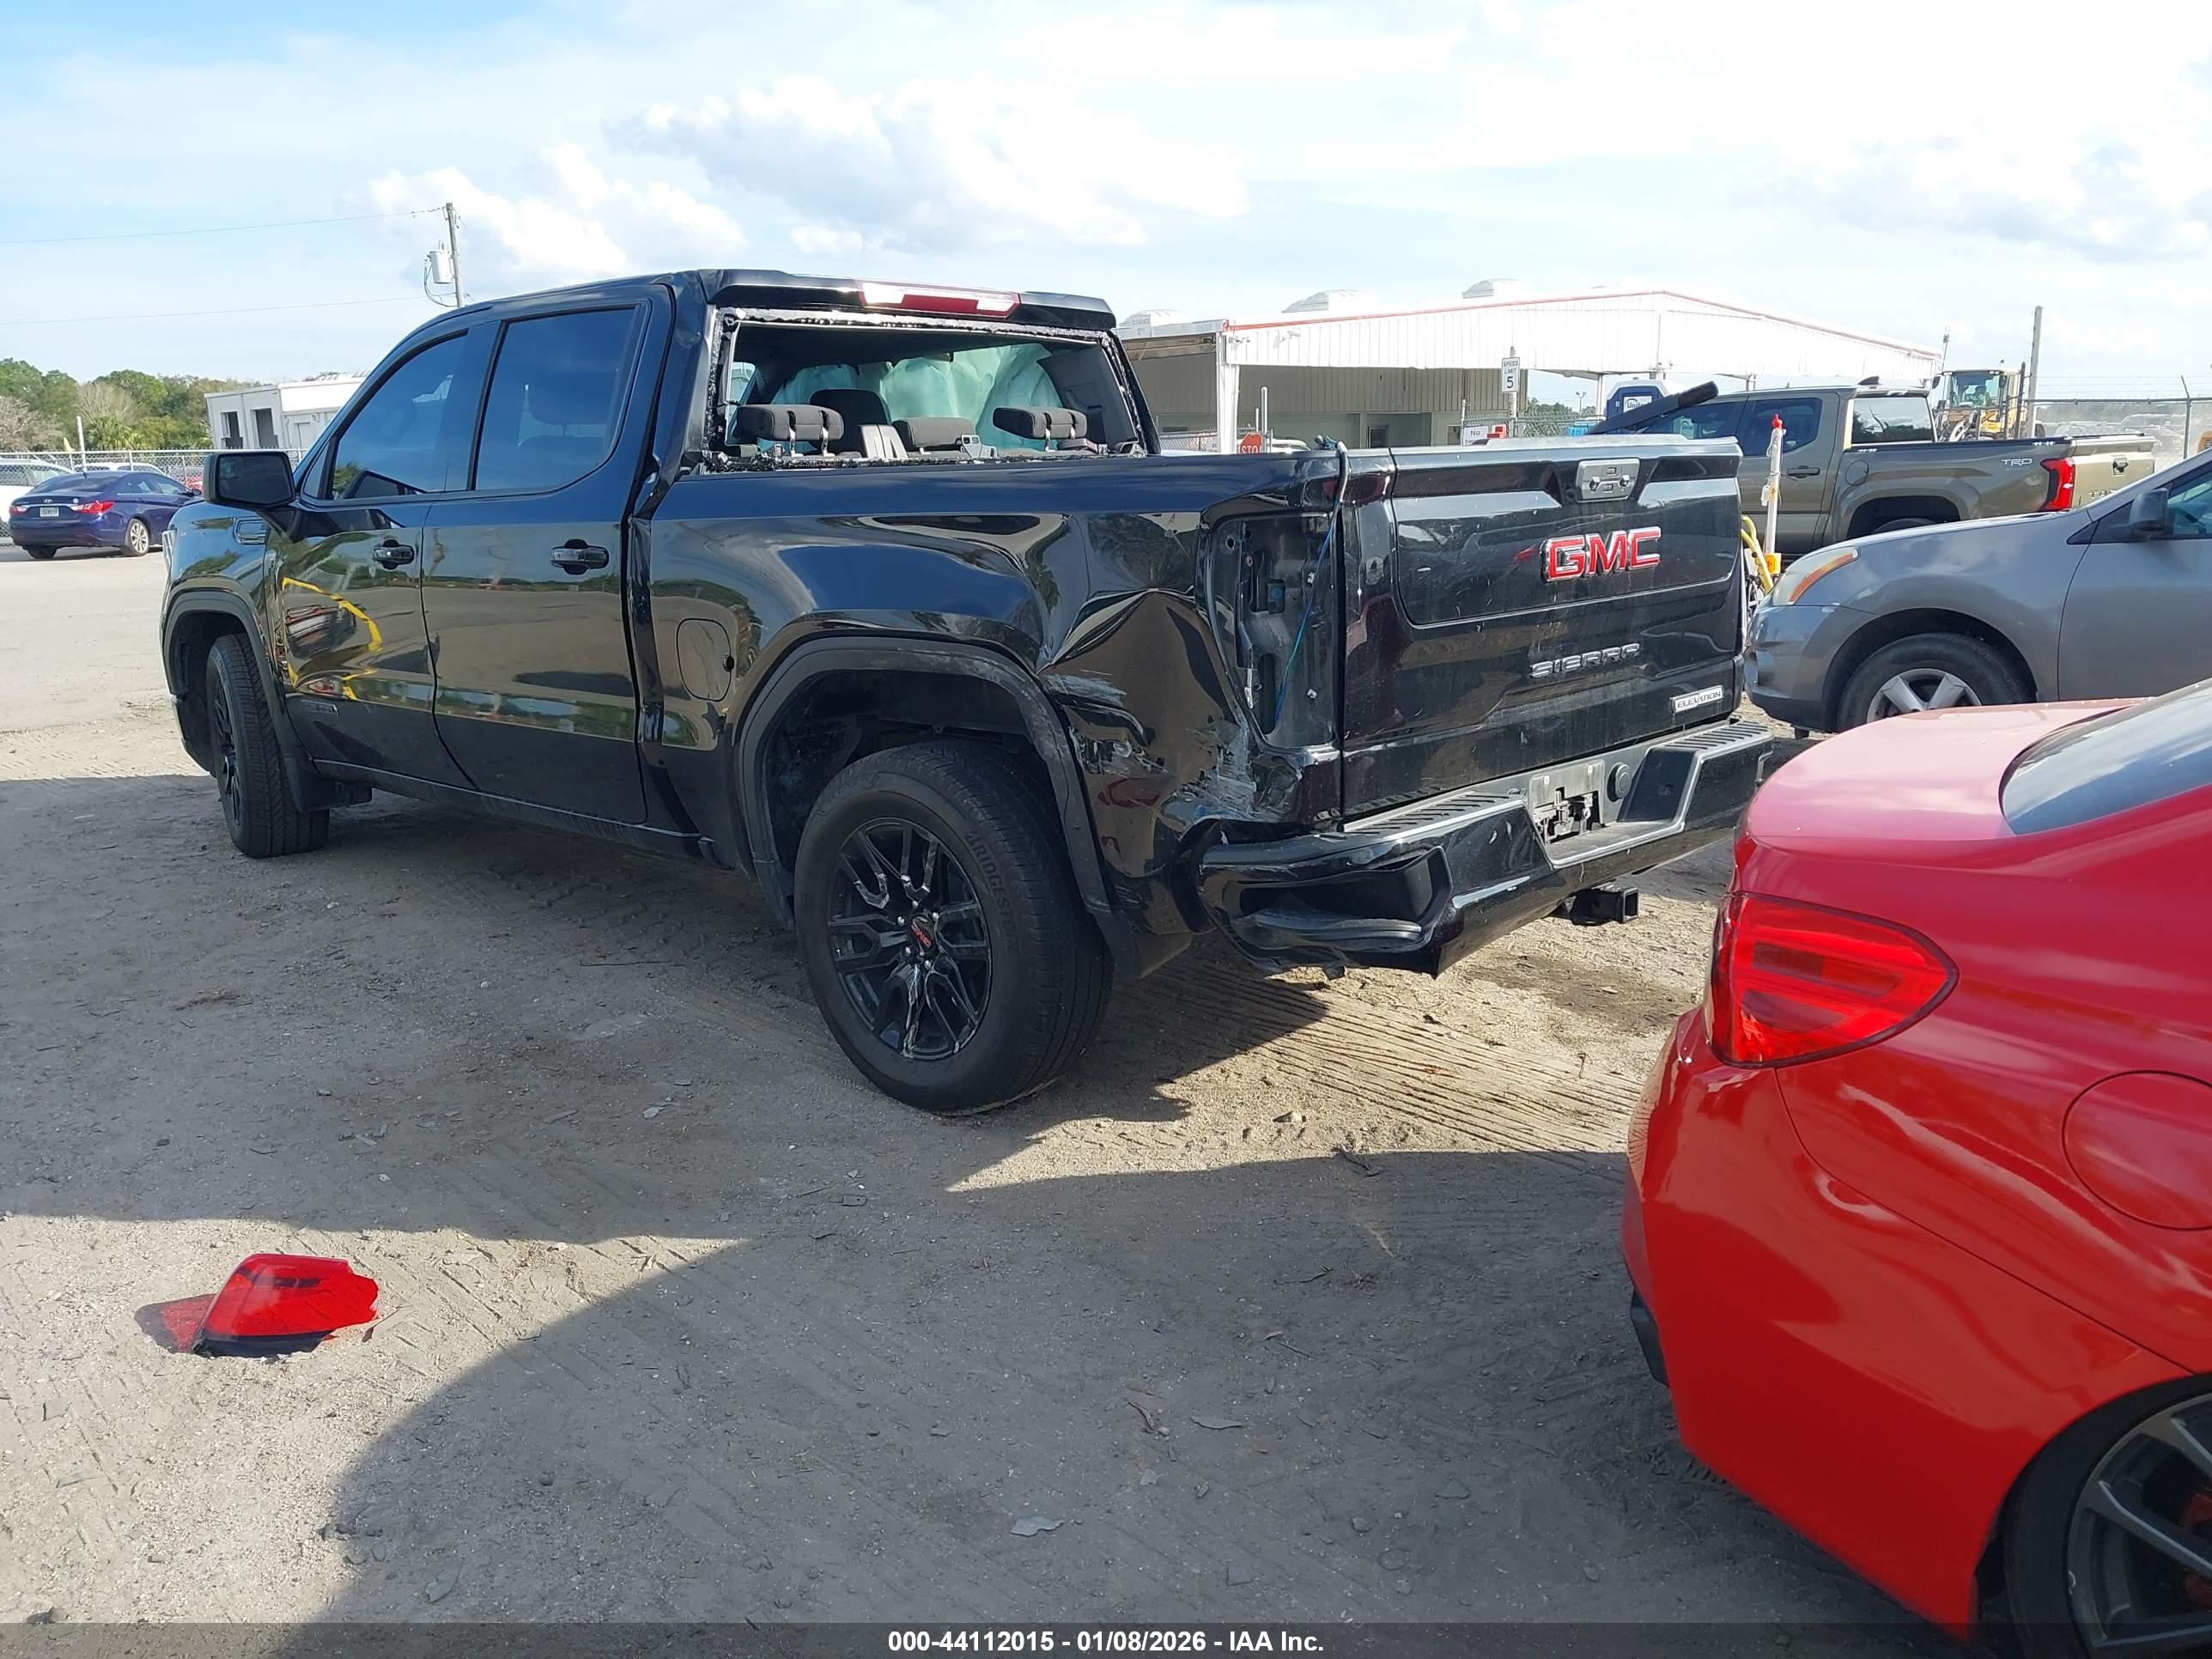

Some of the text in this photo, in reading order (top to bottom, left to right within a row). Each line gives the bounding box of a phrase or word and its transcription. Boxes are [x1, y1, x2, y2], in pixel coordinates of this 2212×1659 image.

[1507, 376, 1514, 389] 5
[2001, 458, 2033, 467] TRD
[1543, 526, 1662, 582] GMC
[1529, 642, 1640, 678] SIERRA
[1676, 690, 1721, 708] ELEVATION
